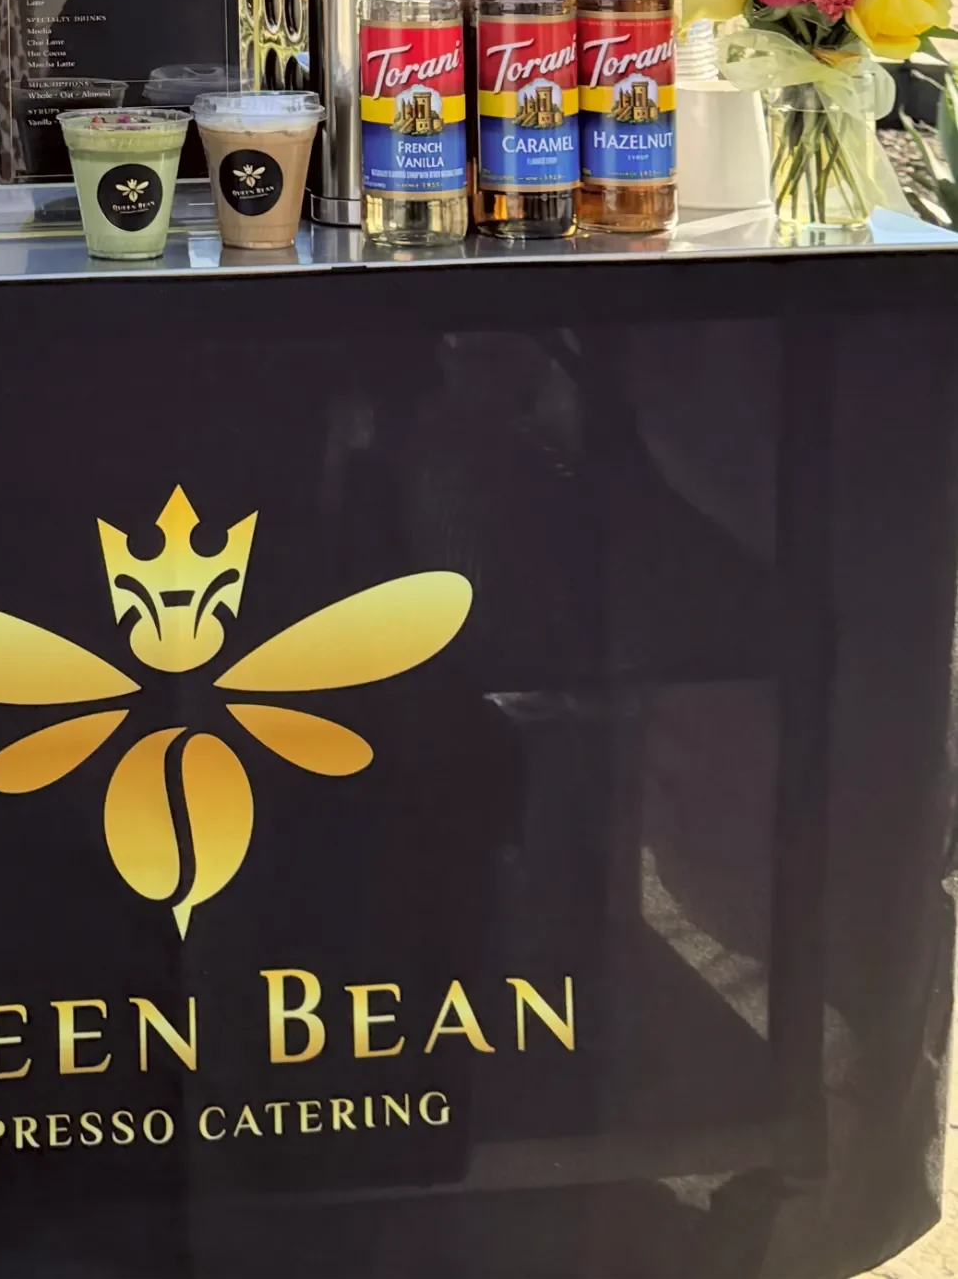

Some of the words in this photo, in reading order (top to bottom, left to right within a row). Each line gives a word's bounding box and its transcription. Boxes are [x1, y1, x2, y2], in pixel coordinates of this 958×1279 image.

[26, 0, 45, 7] Latte
[74, 15, 107, 23] DRINKS
[27, 39, 44, 47] Chai
[46, 38, 65, 46] Latte
[43, 49, 67, 57] Cocoa
[57, 60, 76, 68] Latte
[487, 33, 577, 94] Torani
[583, 30, 674, 89] Torani
[367, 40, 461, 99] Torani
[28, 91, 53, 100] Whole
[60, 91, 75, 99] Oat
[82, 89, 111, 98] Almond
[28, 119, 53, 127] Vanilla
[502, 135, 574, 153] CARAMEL
[593, 130, 673, 150] HAZELNUT
[398, 141, 443, 153] FRENCH
[396, 155, 444, 168] VANILLA
[260, 968, 576, 1064] BEAN
[198, 1091, 451, 1141] CATERING
